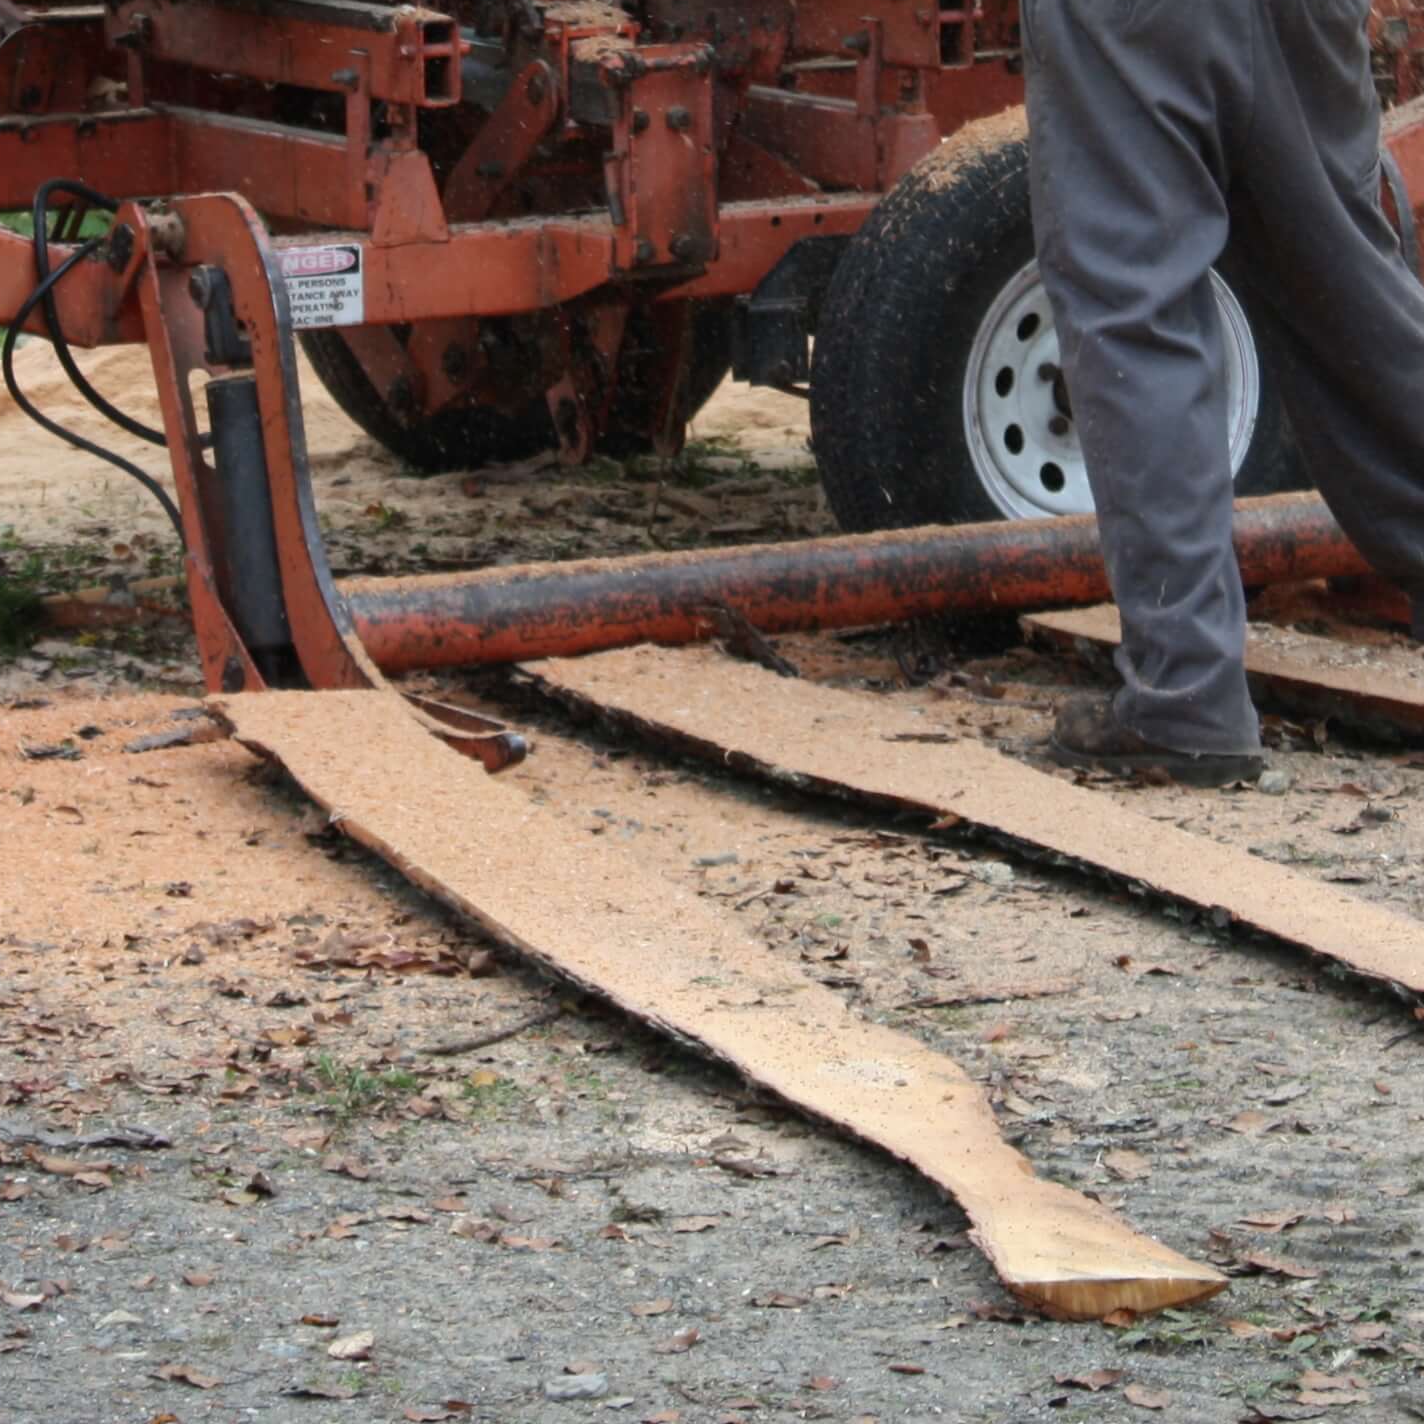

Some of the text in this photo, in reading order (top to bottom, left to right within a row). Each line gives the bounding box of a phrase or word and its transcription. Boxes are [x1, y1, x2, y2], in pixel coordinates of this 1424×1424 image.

[282, 254, 348, 271] NGER
[298, 278, 346, 288] PERSONS
[291, 290, 325, 301] TANCE
